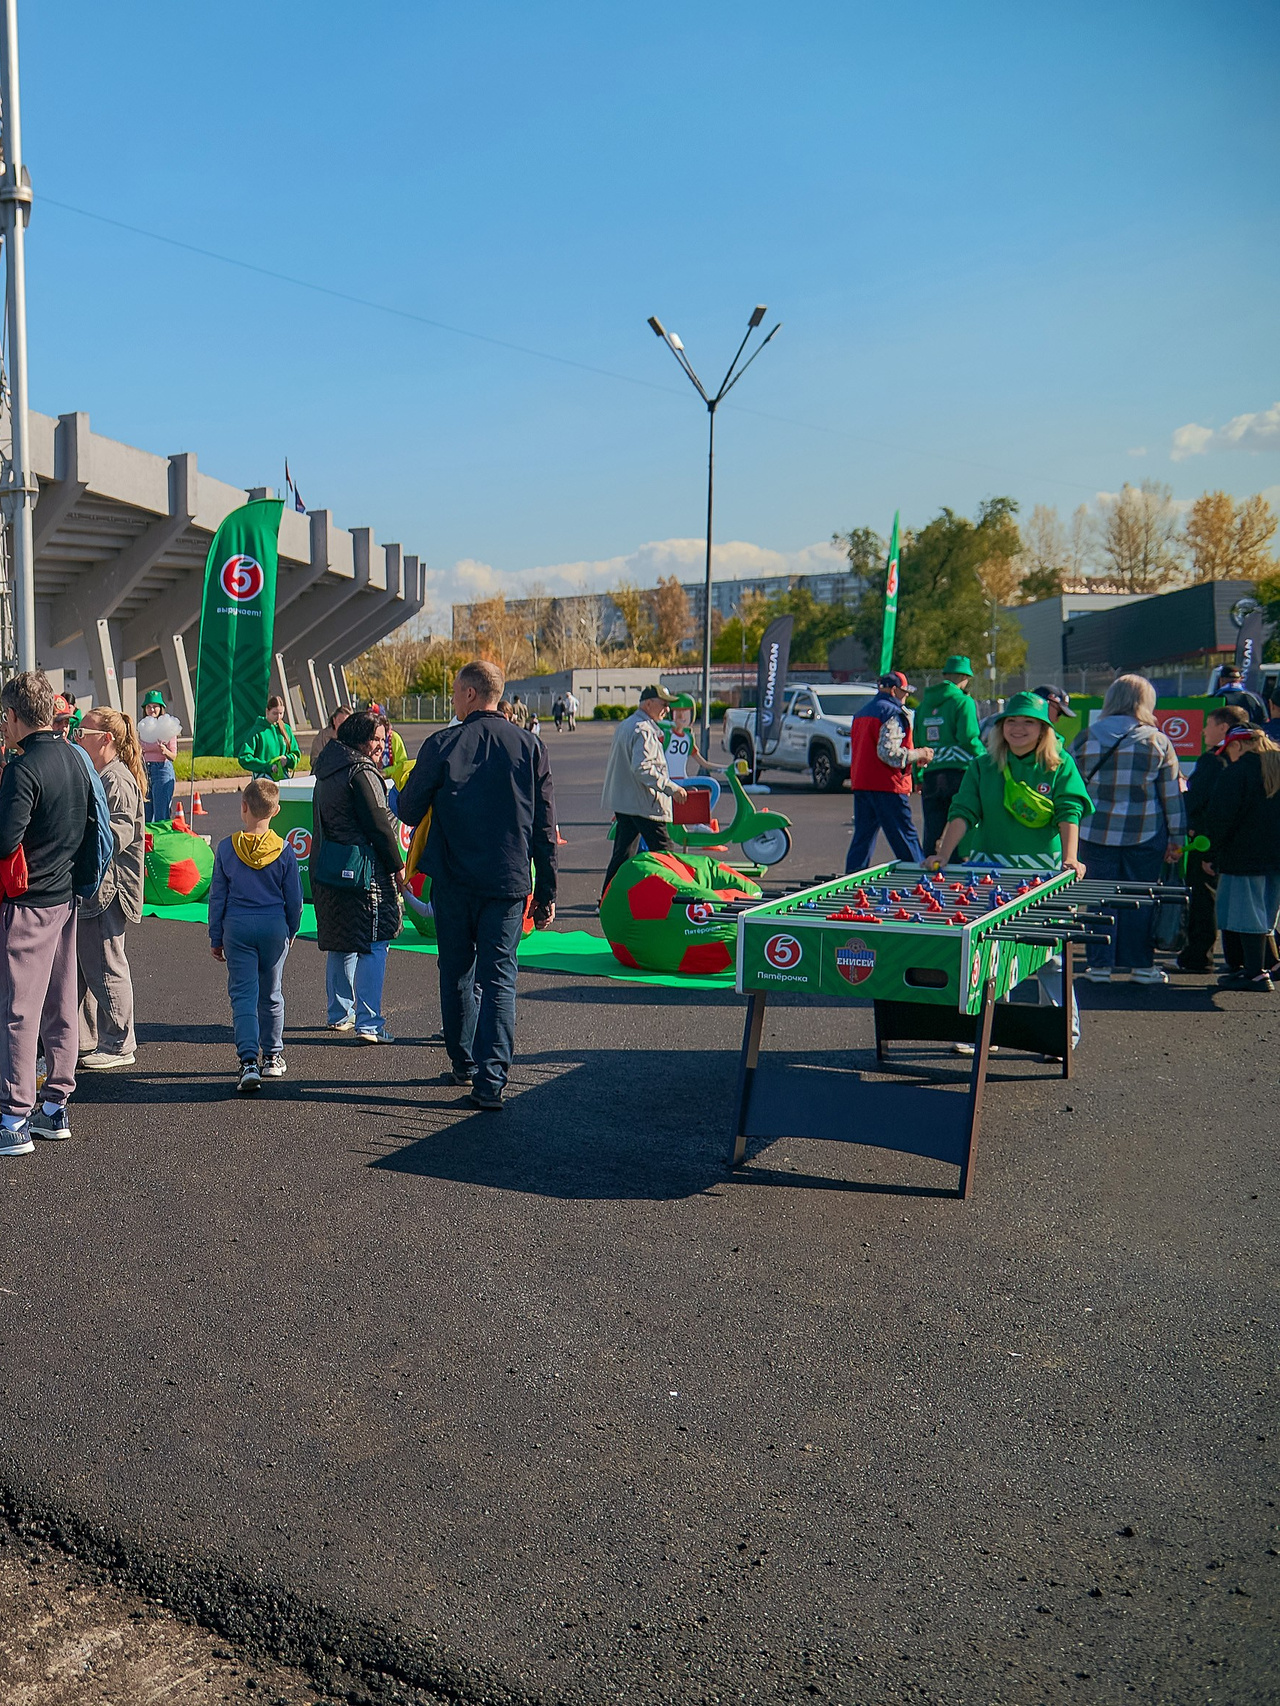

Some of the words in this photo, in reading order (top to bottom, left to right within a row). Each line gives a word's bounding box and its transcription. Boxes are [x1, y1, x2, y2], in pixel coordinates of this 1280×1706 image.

[216, 607, 261, 617] выручает!
[764, 643, 779, 709] CHANGAN
[670, 739, 689, 754] 30
[837, 957, 874, 967] ЕНИСЕЙ
[757, 971, 808, 982] Пятёрочка
